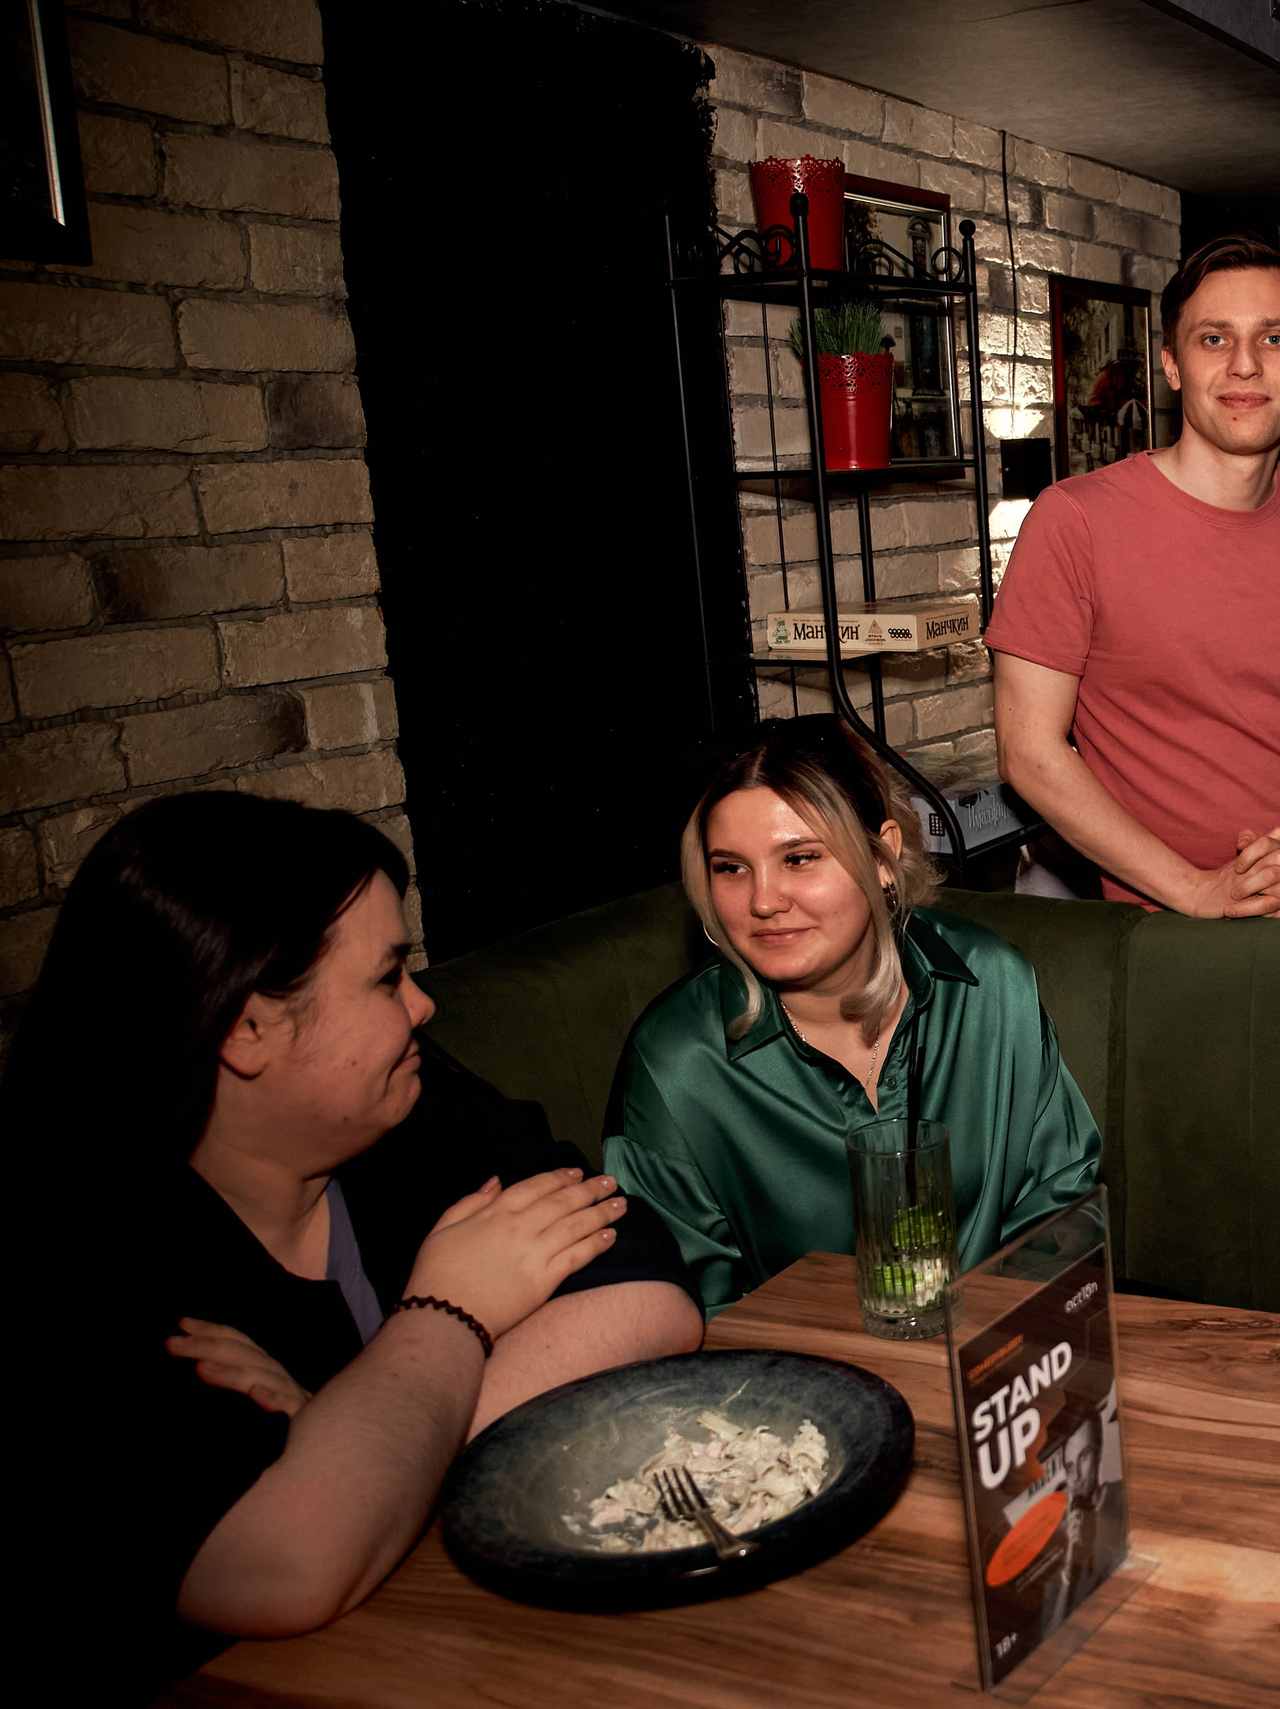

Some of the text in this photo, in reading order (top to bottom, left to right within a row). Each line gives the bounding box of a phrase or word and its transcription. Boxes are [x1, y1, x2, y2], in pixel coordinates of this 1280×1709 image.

[793, 622, 861, 644] Манин
[925, 615, 970, 640] Манчкин
[971, 1340, 1074, 1443] STAND
[976, 1406, 1042, 1490] UP
[994, 1632, 1018, 1659] 18+
